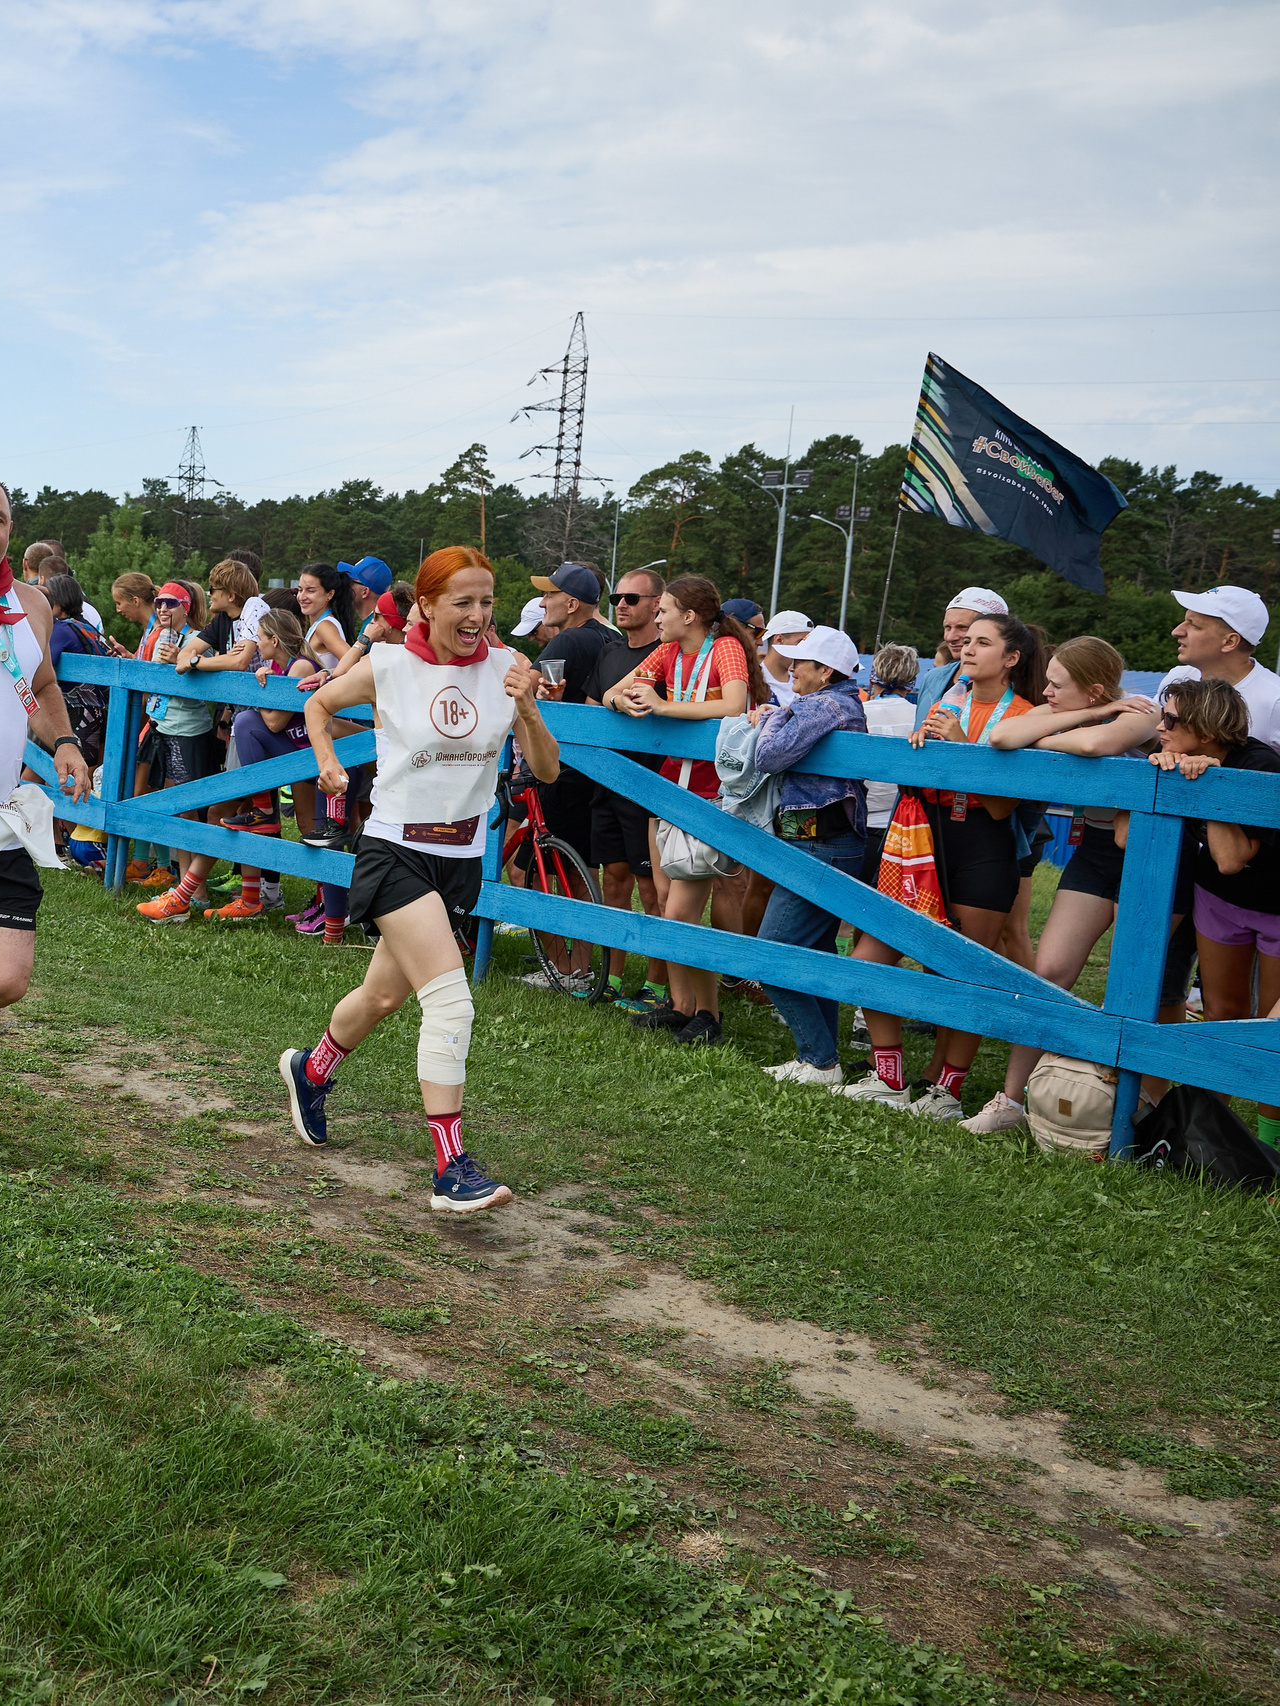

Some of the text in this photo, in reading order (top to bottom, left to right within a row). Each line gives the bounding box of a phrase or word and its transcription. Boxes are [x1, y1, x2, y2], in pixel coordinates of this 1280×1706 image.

[439, 700, 470, 726] 18+
[12, 915, 34, 923] TRAINING
[886, 1058, 895, 1080] РЕТРО
